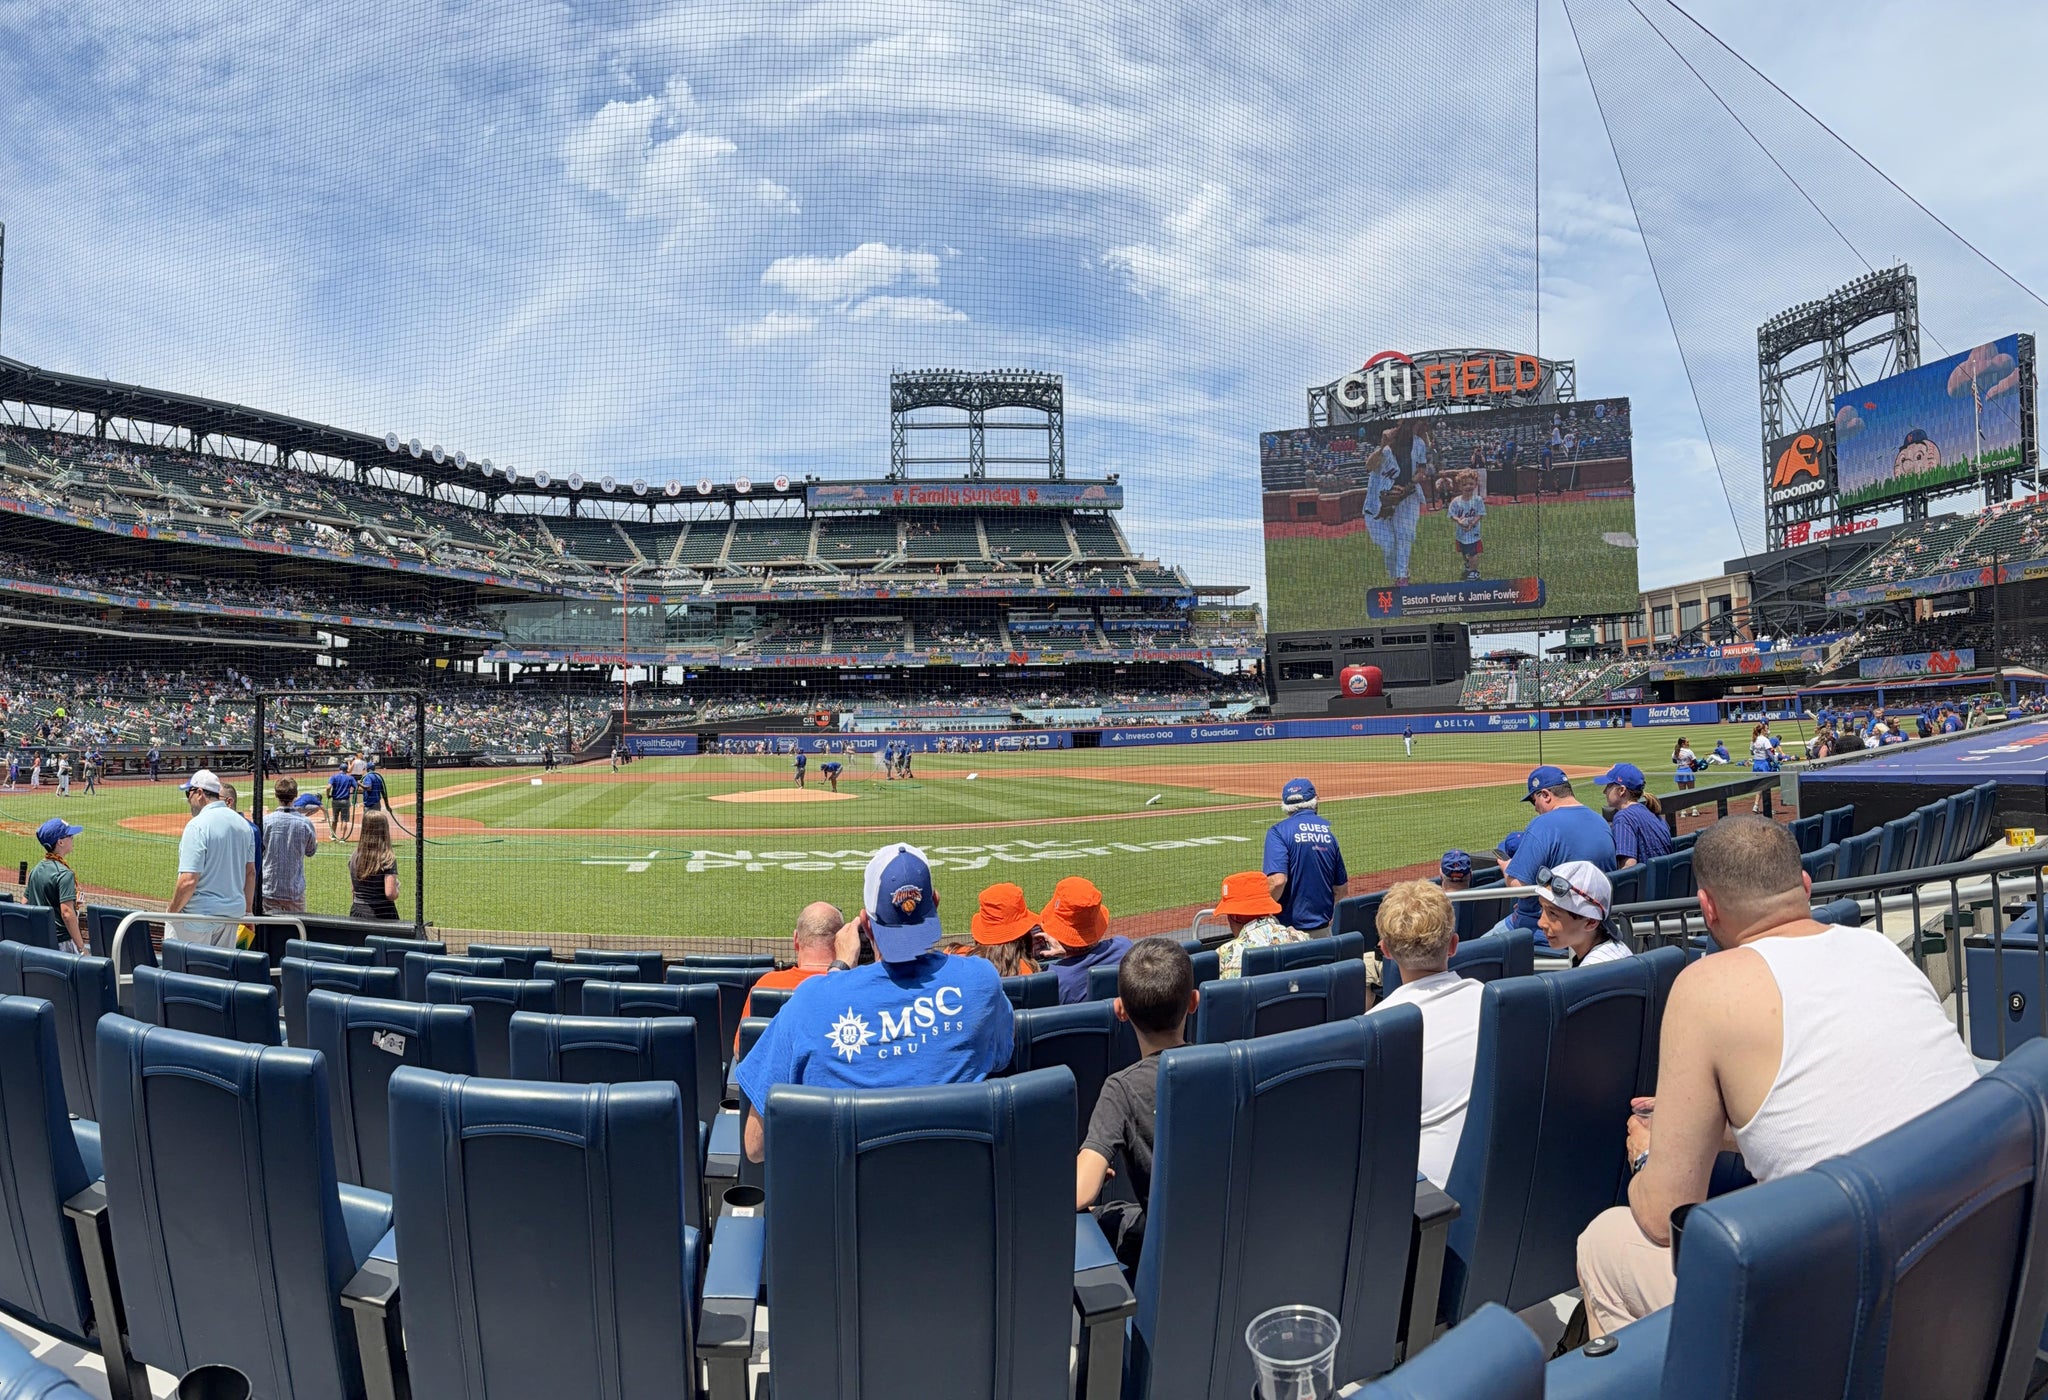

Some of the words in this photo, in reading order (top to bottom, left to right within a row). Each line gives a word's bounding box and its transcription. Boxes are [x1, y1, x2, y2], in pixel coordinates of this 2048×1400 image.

[1337, 358, 1413, 408] citi
[1424, 354, 1541, 401] FIELD
[390, 437, 395, 447] 5
[457, 455, 465, 465] 24
[1991, 455, 2016, 467] Crayola
[484, 463, 491, 472] 17
[539, 475, 546, 484] 31
[604, 480, 612, 488] 14
[776, 479, 787, 488] 42
[635, 483, 645, 491] 37
[1772, 479, 1825, 502] moomoo
[908, 485, 959, 507] Family
[962, 485, 1020, 506] Sunday
[1813, 528, 1833, 540] new
[1833, 518, 1879, 535] balance
[1961, 574, 1975, 585] VS
[1402, 595, 1428, 606] Easton
[1431, 593, 1457, 603] Fowler
[1458, 593, 1465, 601] &
[1468, 591, 1491, 602] Jamie
[1493, 588, 1520, 600] Fowler
[1885, 587, 1912, 597] Crayola
[1402, 607, 1434, 616] Ceremonial
[1709, 649, 1720, 657] citi
[1724, 662, 1736, 671] VS
[1906, 659, 1921, 670] VS
[1648, 706, 1669, 717] Hard
[1670, 705, 1690, 718] Rock
[1443, 719, 1475, 728] DELTA
[1200, 728, 1239, 737] Guardian
[1254, 724, 1275, 736] citi
[999, 734, 1050, 746] GECO
[1125, 731, 1155, 740] Invesco
[1156, 731, 1174, 739] QQQ
[635, 738, 687, 749] HealthEquity
[832, 739, 878, 748] HYNDAI
[690, 838, 1094, 860] Nework-
[2013, 998, 2020, 1007] 5
[878, 985, 963, 1044] MSC
[878, 1020, 963, 1060] CRUISES
